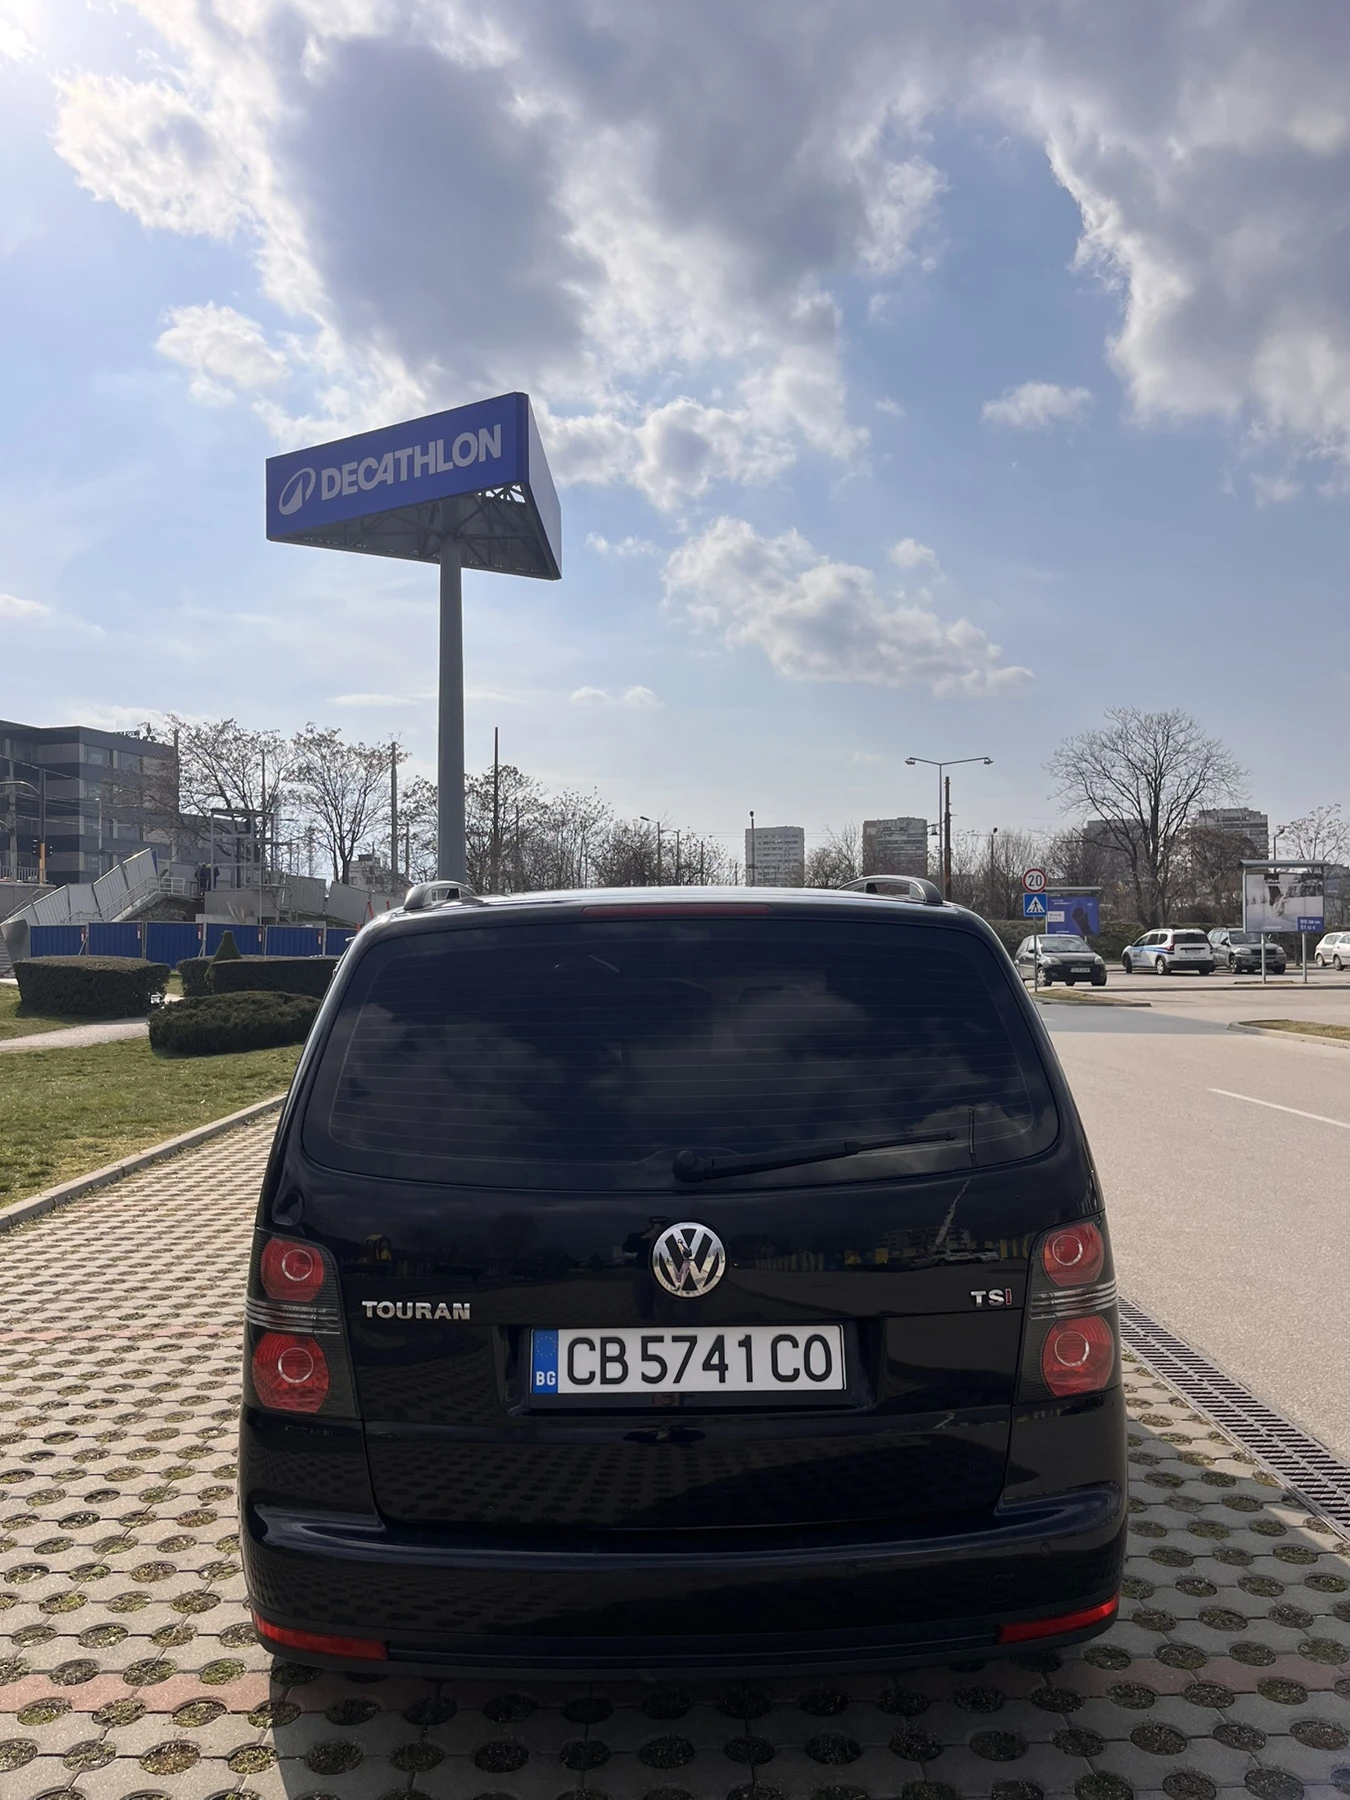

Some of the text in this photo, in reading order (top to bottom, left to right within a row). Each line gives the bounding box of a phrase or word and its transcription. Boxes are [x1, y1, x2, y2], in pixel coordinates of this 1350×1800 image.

[321, 424, 501, 500] DECATHLON
[1028, 875, 1042, 887] 20
[362, 1301, 470, 1320] TOURAN
[567, 1336, 629, 1385] CB
[641, 1334, 753, 1384] 5741
[536, 1371, 556, 1386] BG
